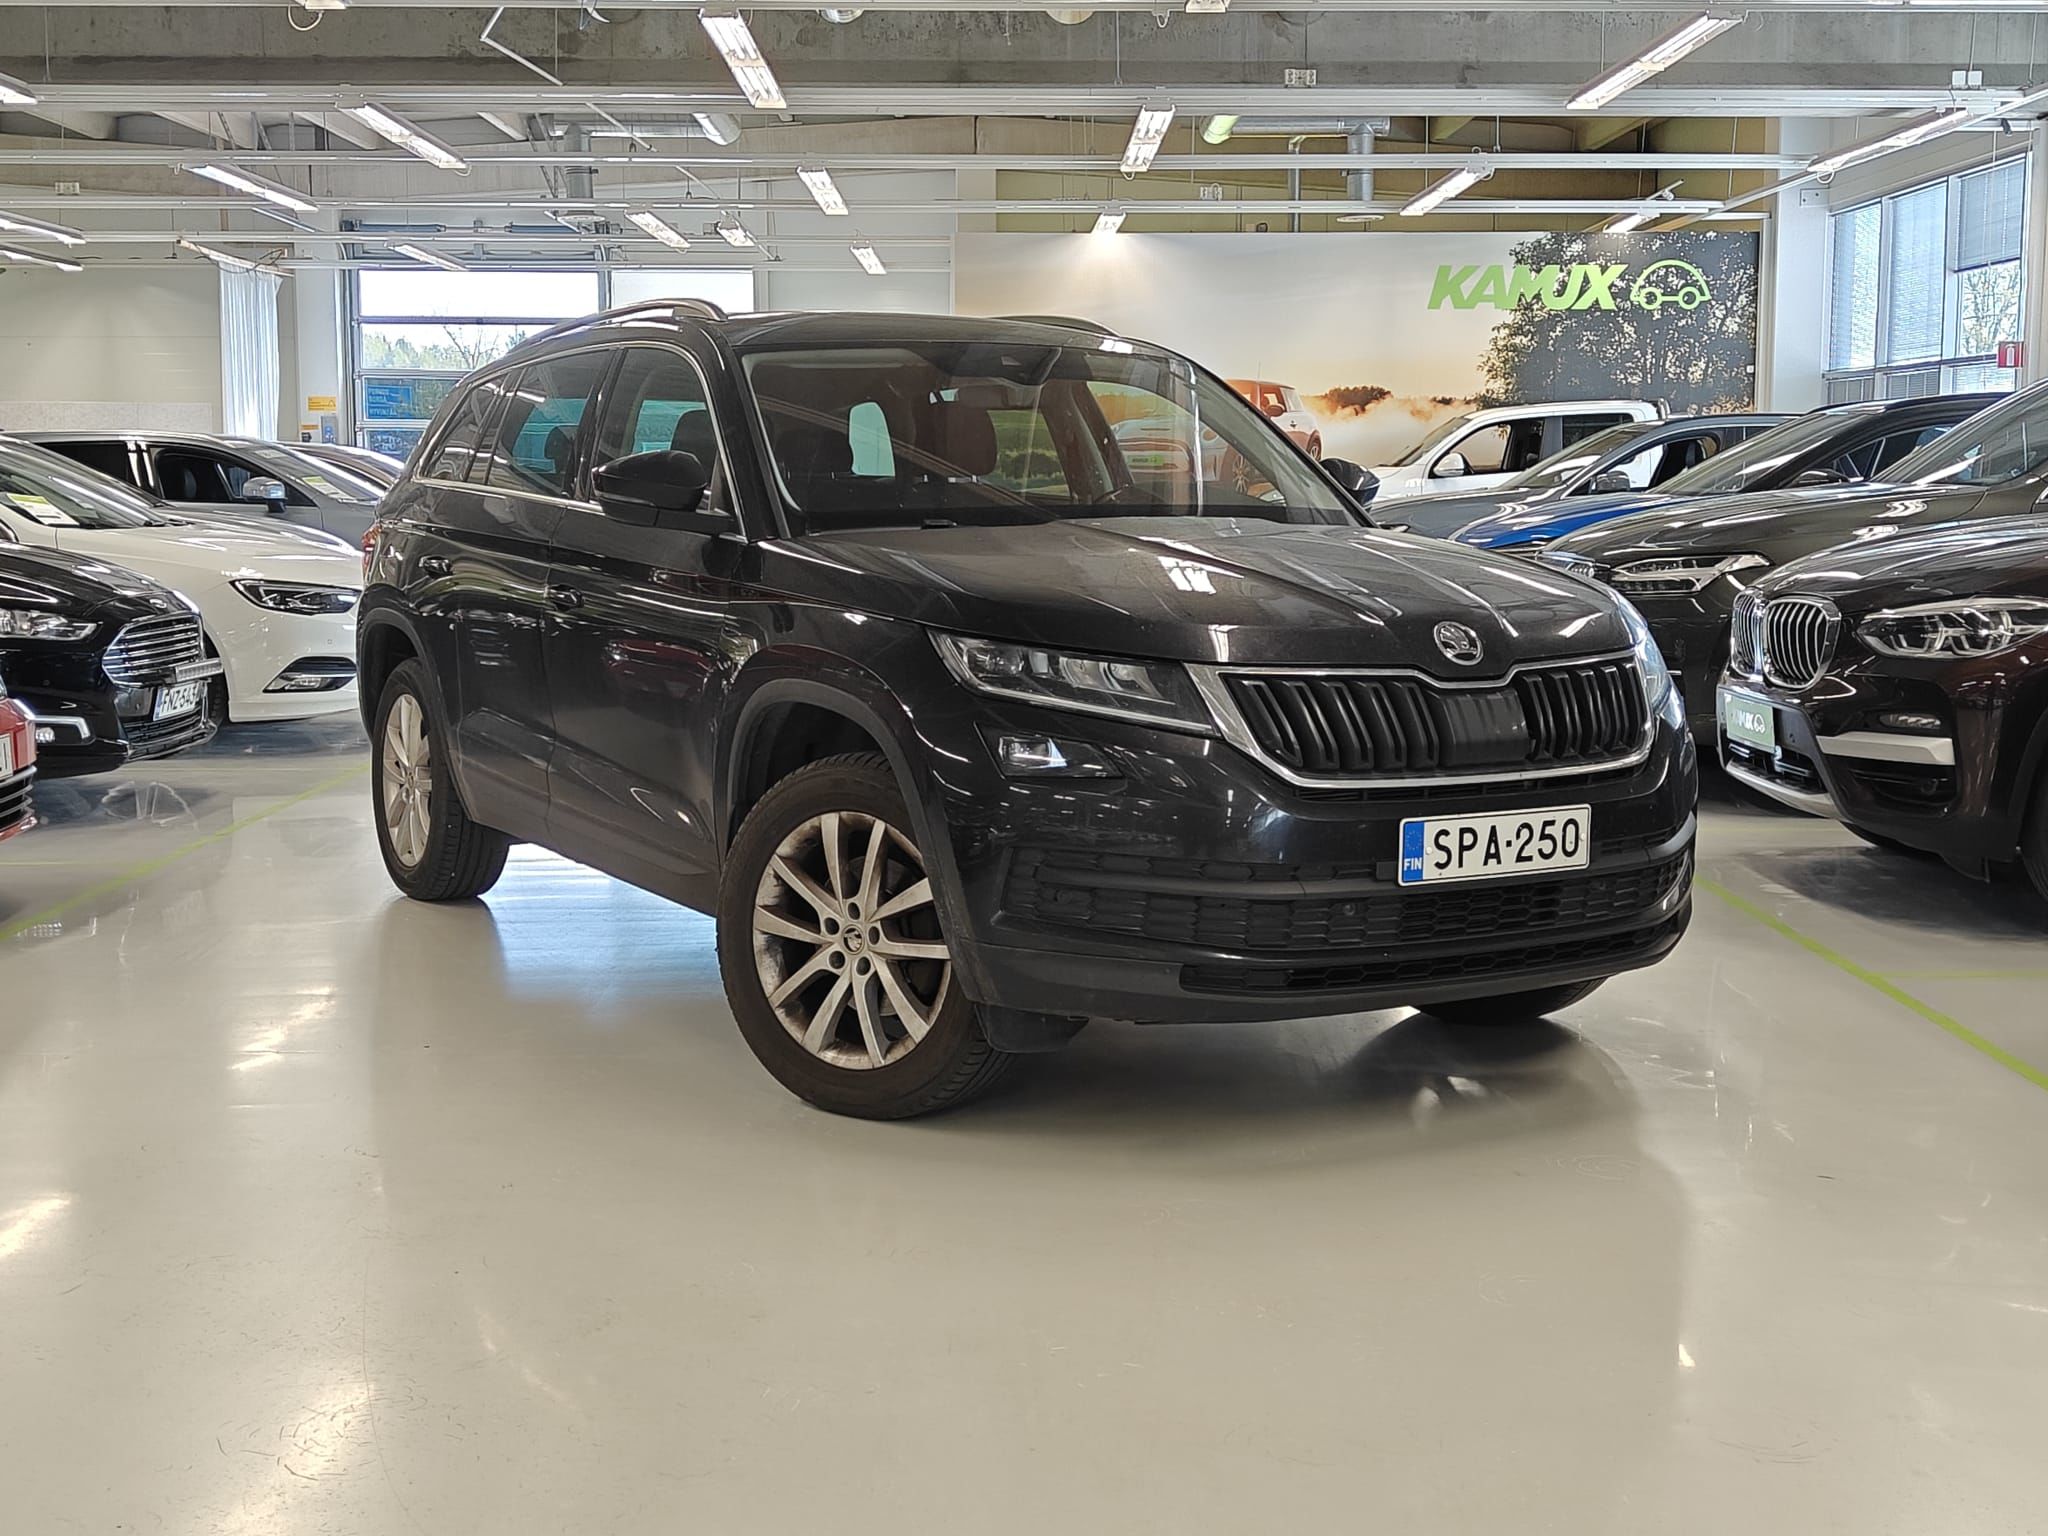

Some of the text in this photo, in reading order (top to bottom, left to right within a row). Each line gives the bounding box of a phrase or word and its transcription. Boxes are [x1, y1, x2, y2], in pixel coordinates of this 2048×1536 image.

[1427, 264, 1628, 310] KAMUX
[1403, 857, 1422, 871] FIN
[1433, 817, 1580, 870] SPA-250
